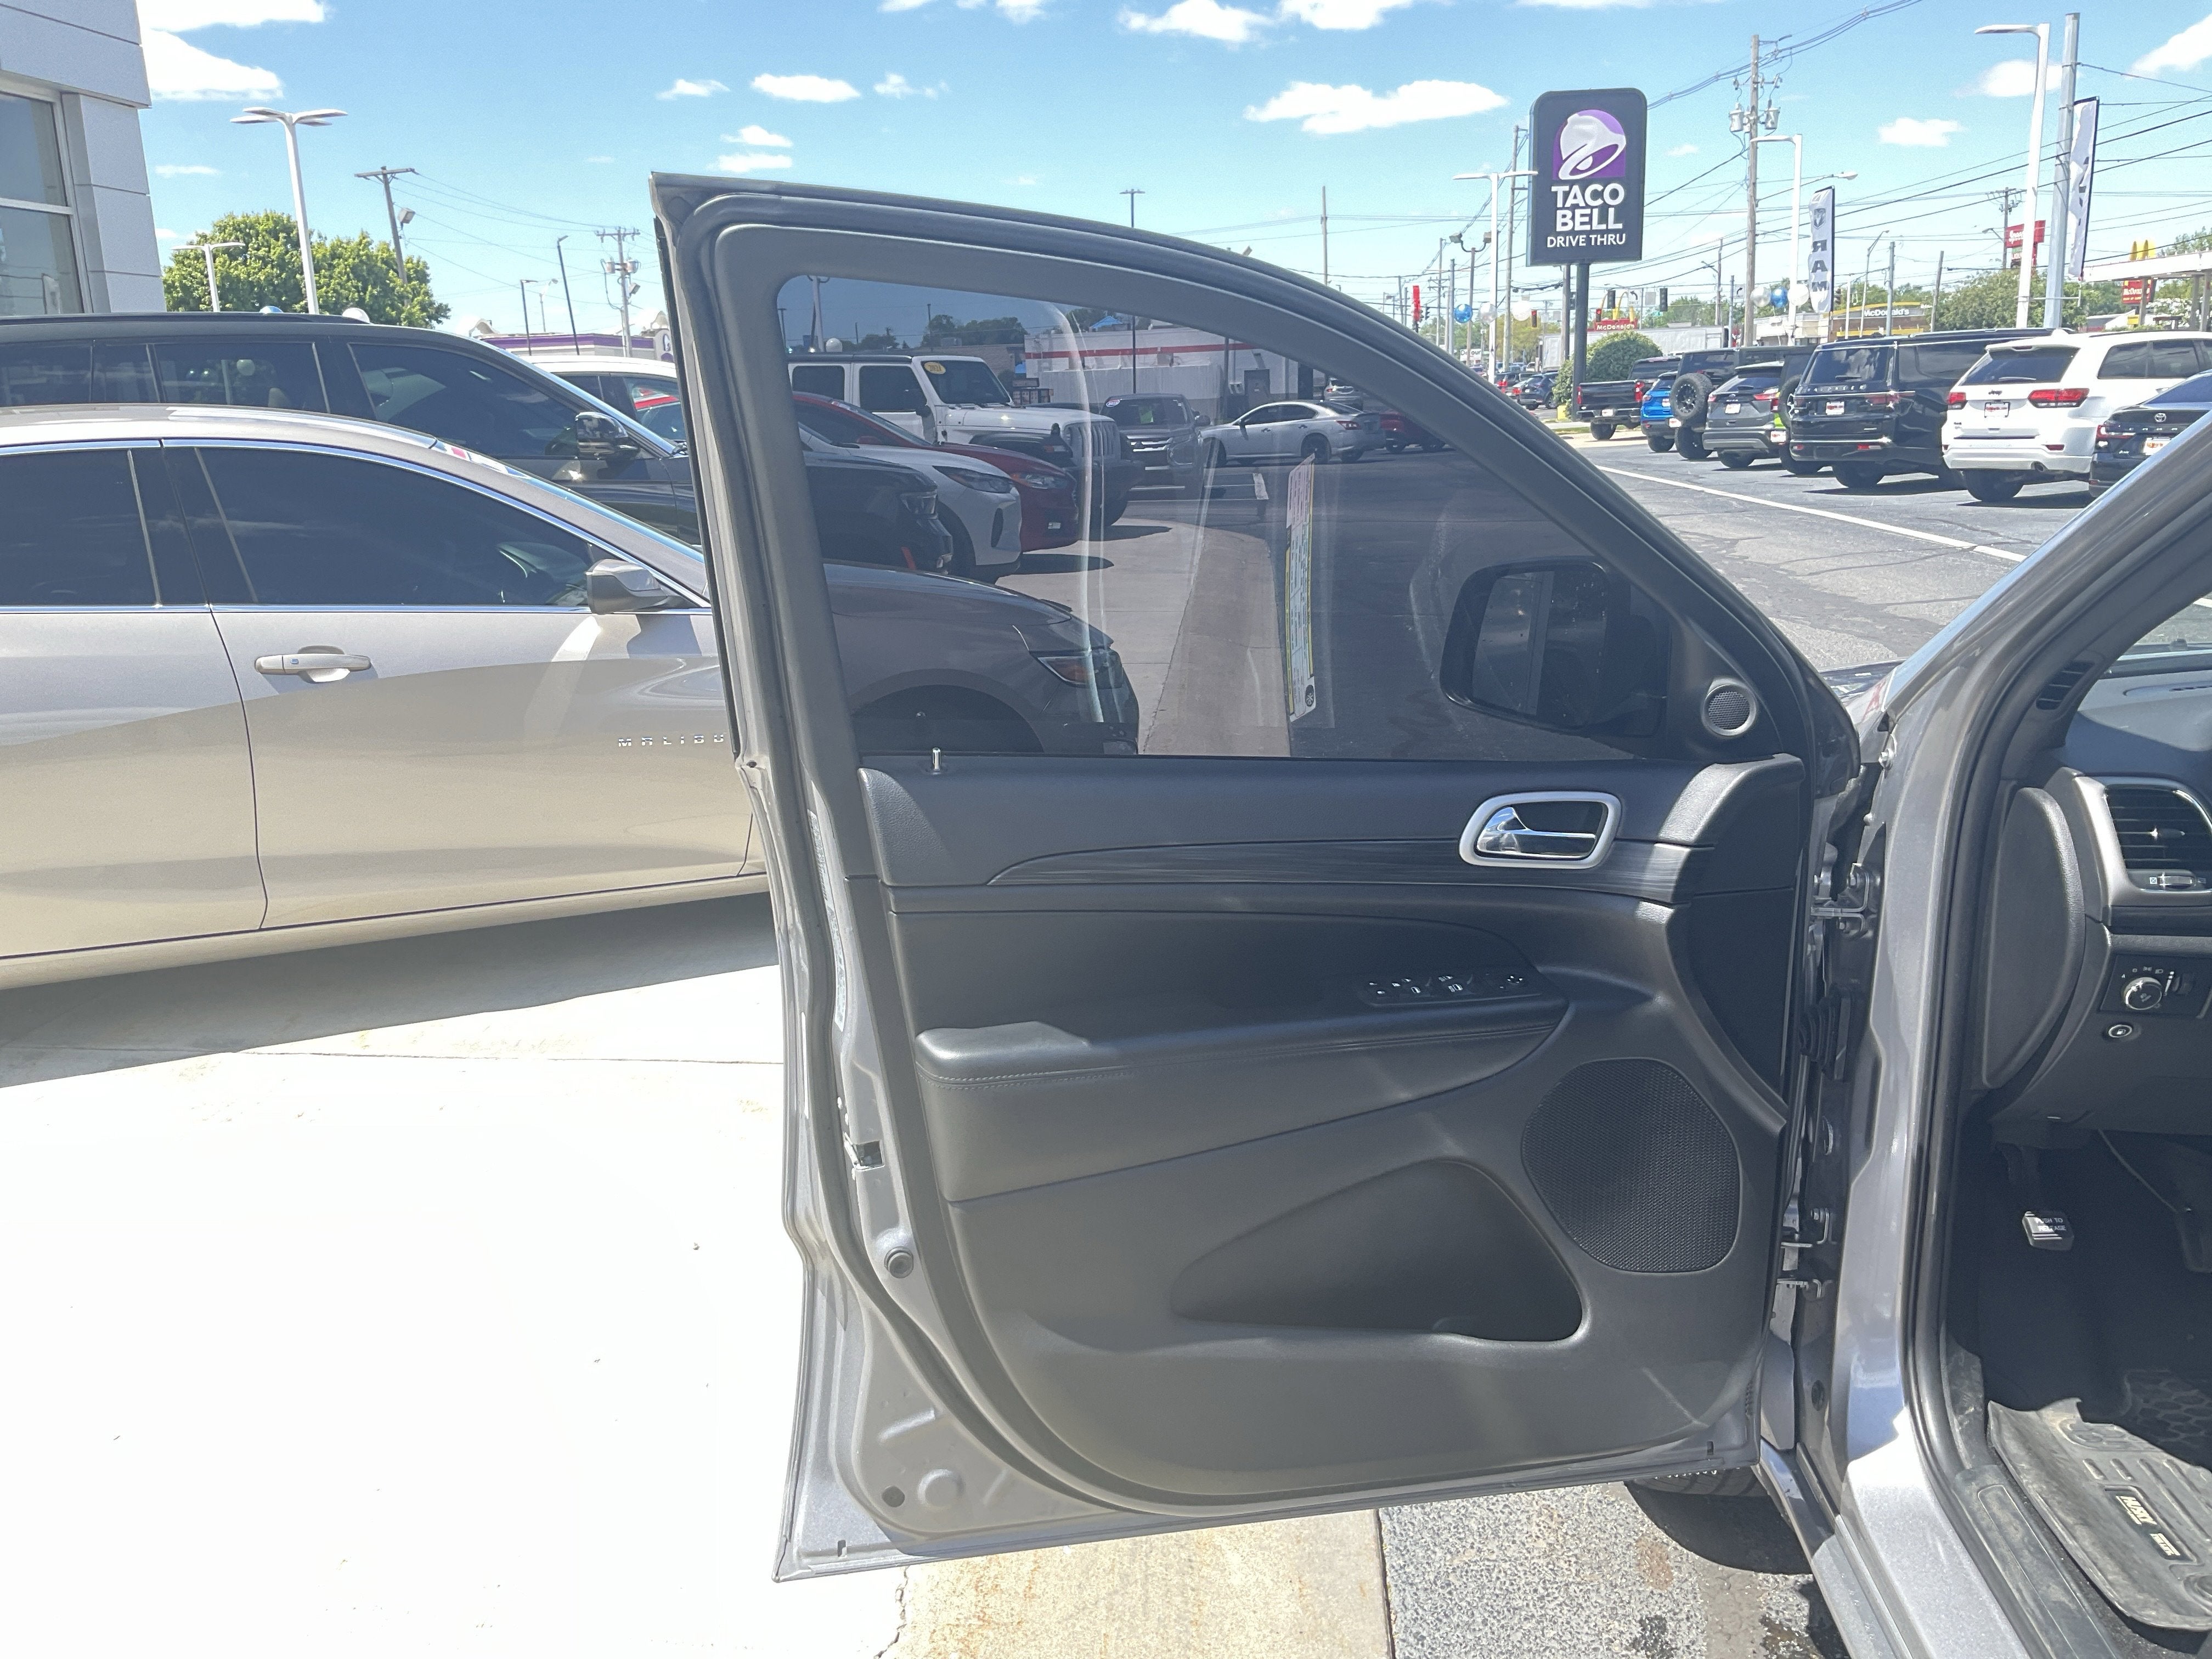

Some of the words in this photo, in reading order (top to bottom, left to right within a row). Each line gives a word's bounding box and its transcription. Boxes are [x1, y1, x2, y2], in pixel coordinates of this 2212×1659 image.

[1551, 183, 1625, 208] TACO
[1556, 207, 1623, 232] BELL
[1547, 235, 1587, 247] DRIVE
[1589, 233, 1626, 246] THRU
[1864, 308, 1910, 317] McDoald's
[618, 733, 724, 747] MALIBU
[2120, 1496, 2157, 1525] HUSKY
